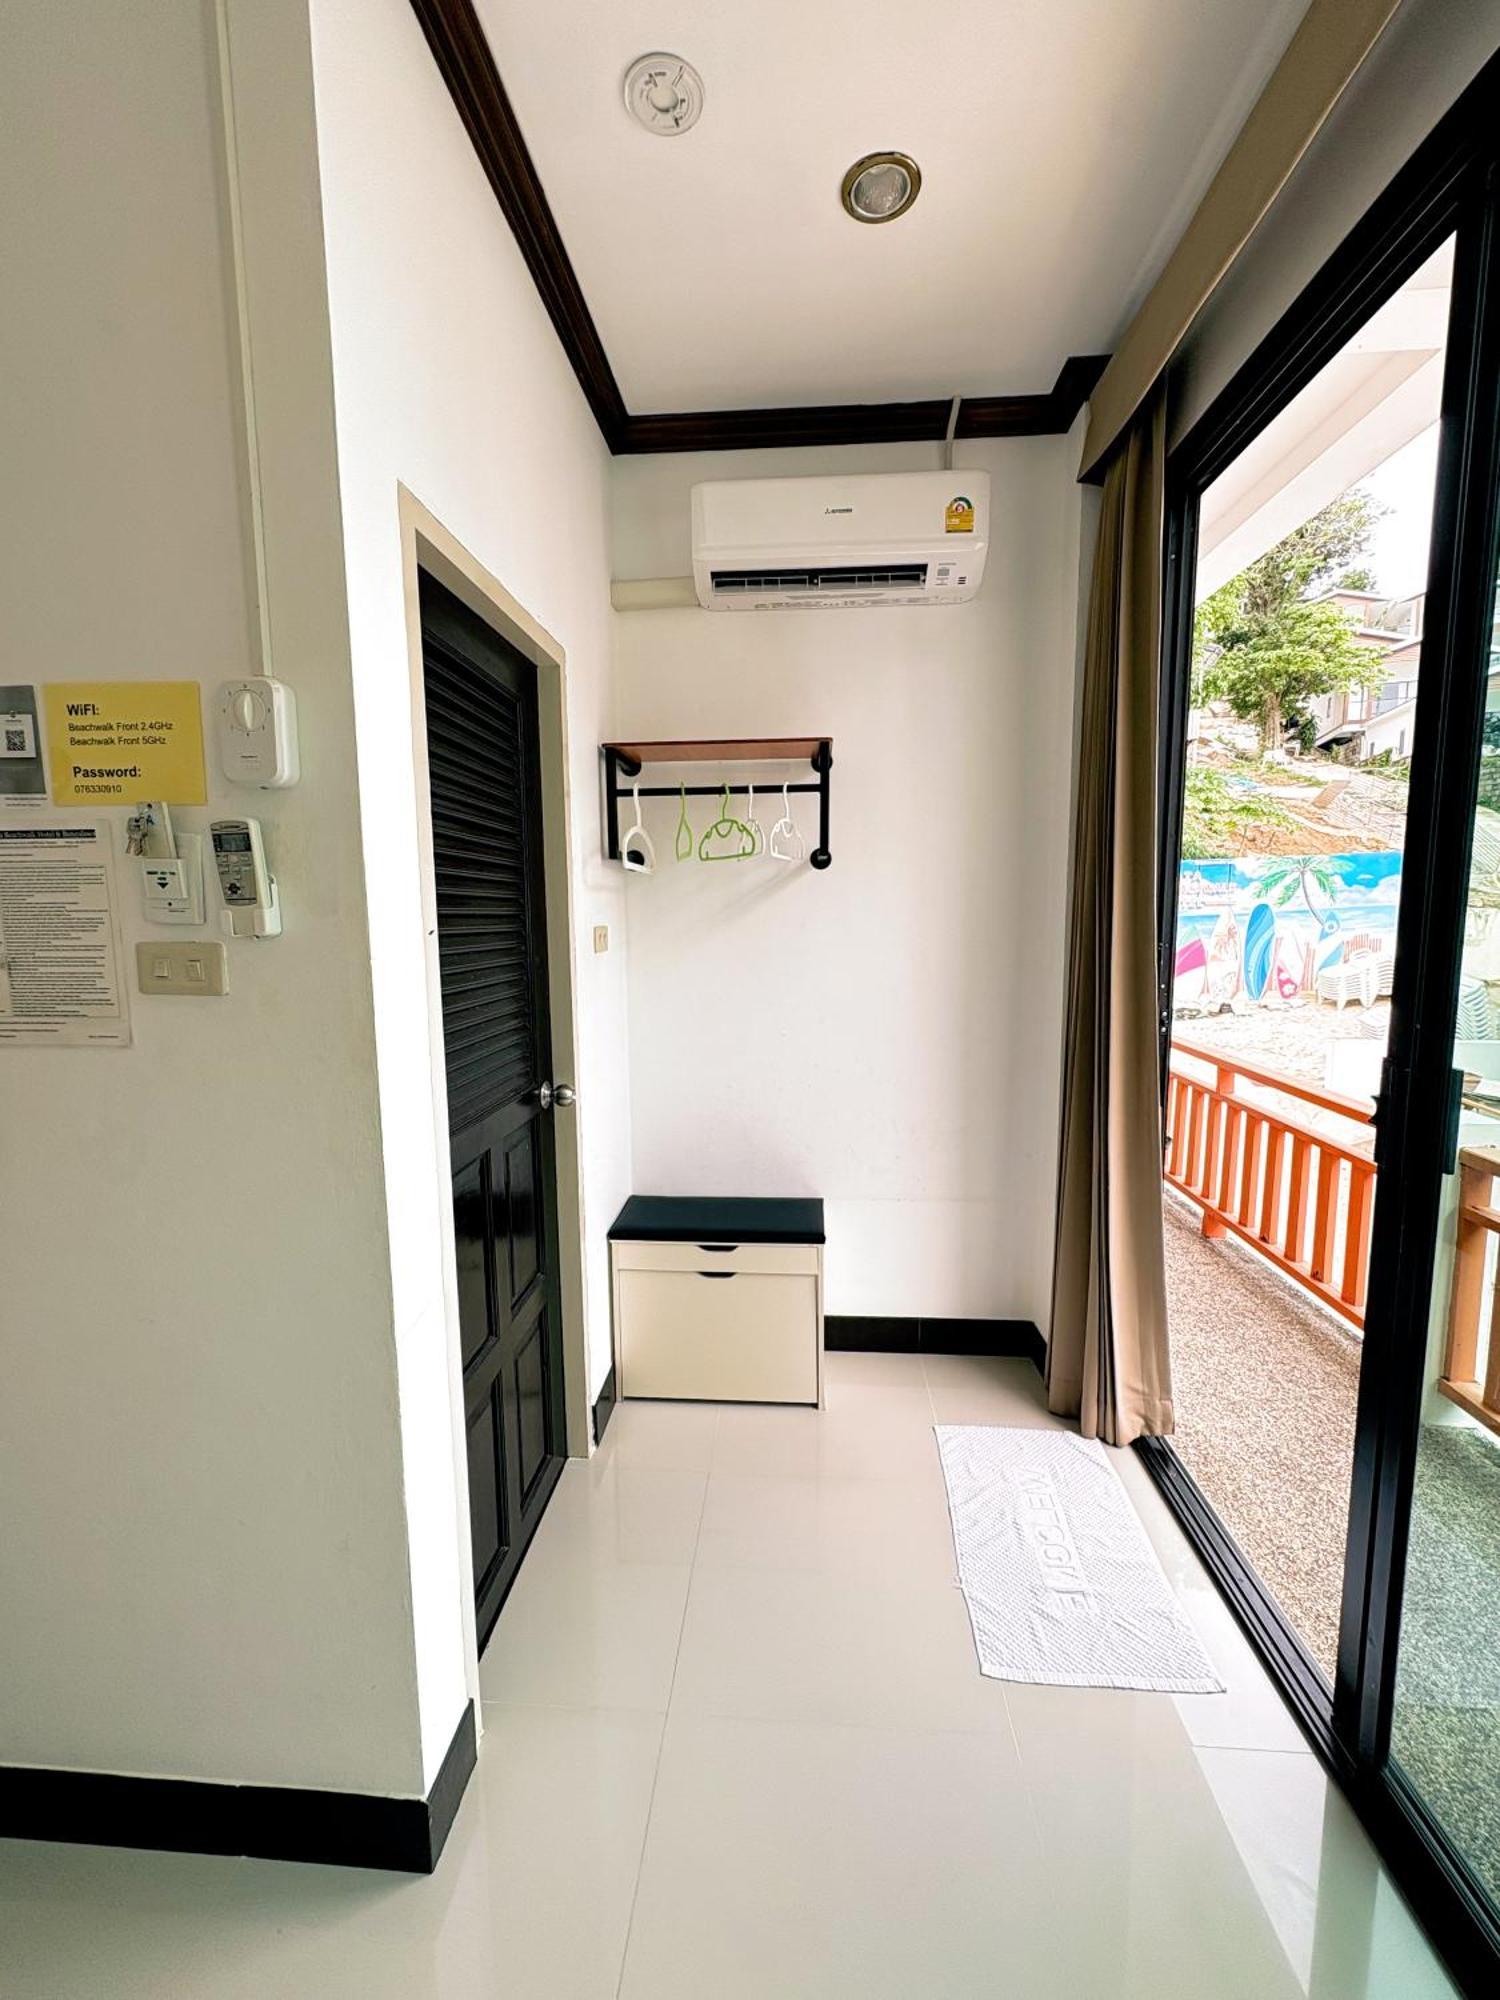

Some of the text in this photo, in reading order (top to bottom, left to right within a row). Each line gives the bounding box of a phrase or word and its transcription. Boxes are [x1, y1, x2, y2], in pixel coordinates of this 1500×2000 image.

[68, 720, 173, 732] Beachwalk Front 2.4GHz
[70, 735, 167, 746] Beachwalk Front 5GHz
[72, 765, 142, 778] Password:
